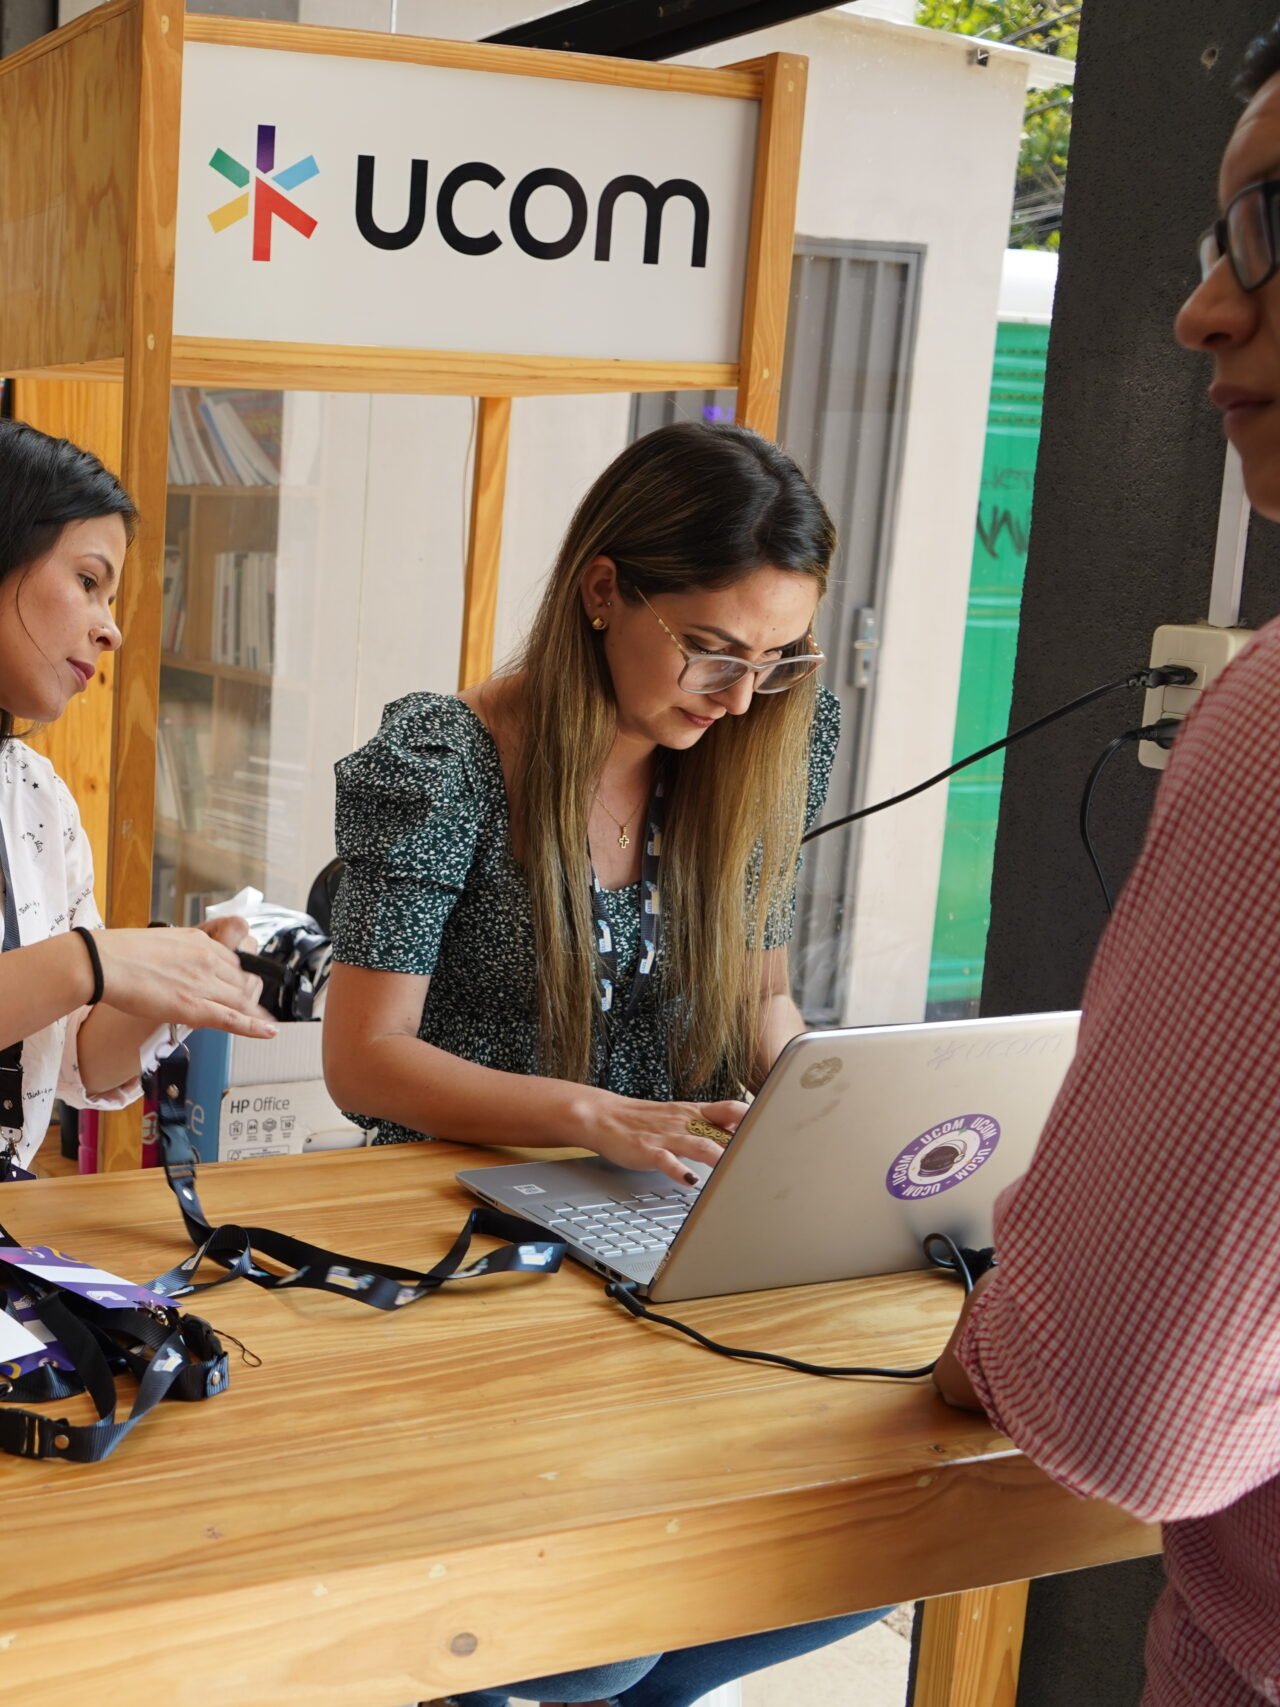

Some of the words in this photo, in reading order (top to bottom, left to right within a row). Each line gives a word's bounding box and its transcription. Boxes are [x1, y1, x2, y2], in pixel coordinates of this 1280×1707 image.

[355, 154, 710, 268] ucom
[230, 1099, 249, 1114] HP
[253, 1097, 290, 1112] Office
[920, 1118, 965, 1144] UCOM
[970, 1116, 998, 1141] UCOM
[892, 1154, 915, 1186] UCOM
[954, 1148, 992, 1180] UCOM
[902, 1183, 941, 1197] UCOM
